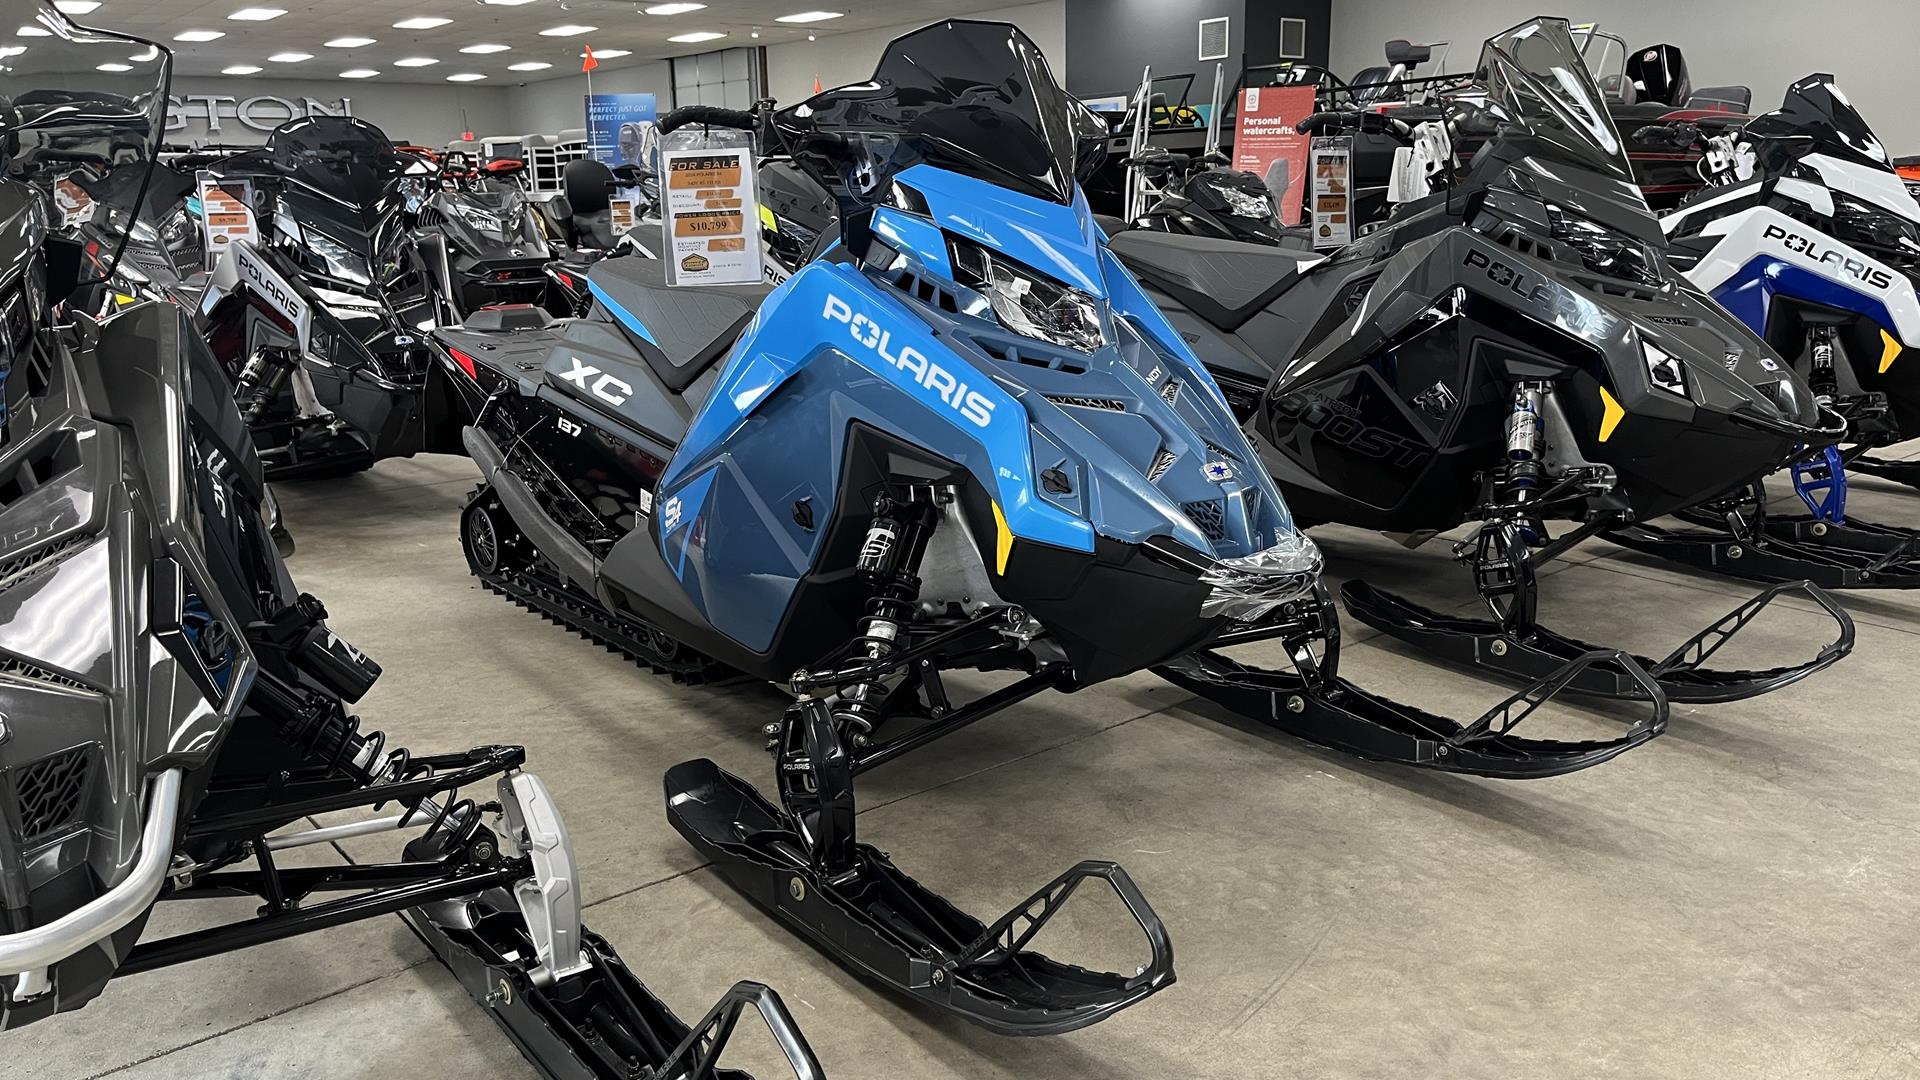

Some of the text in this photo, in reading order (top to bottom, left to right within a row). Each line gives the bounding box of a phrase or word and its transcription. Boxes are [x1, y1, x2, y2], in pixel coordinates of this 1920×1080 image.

[618, 105, 632, 113] JUST
[633, 104, 647, 112] GOT
[1244, 116, 1281, 125] Personal
[1243, 126, 1296, 136] watercrafts,
[670, 160, 739, 171] FOR SALE
[1763, 224, 1893, 290] POLARIS
[239, 254, 299, 318] POLARIS
[1463, 248, 1620, 340] POLARIS
[822, 292, 997, 428] POLARIS
[558, 356, 633, 407] XC
[558, 416, 582, 437] 137
